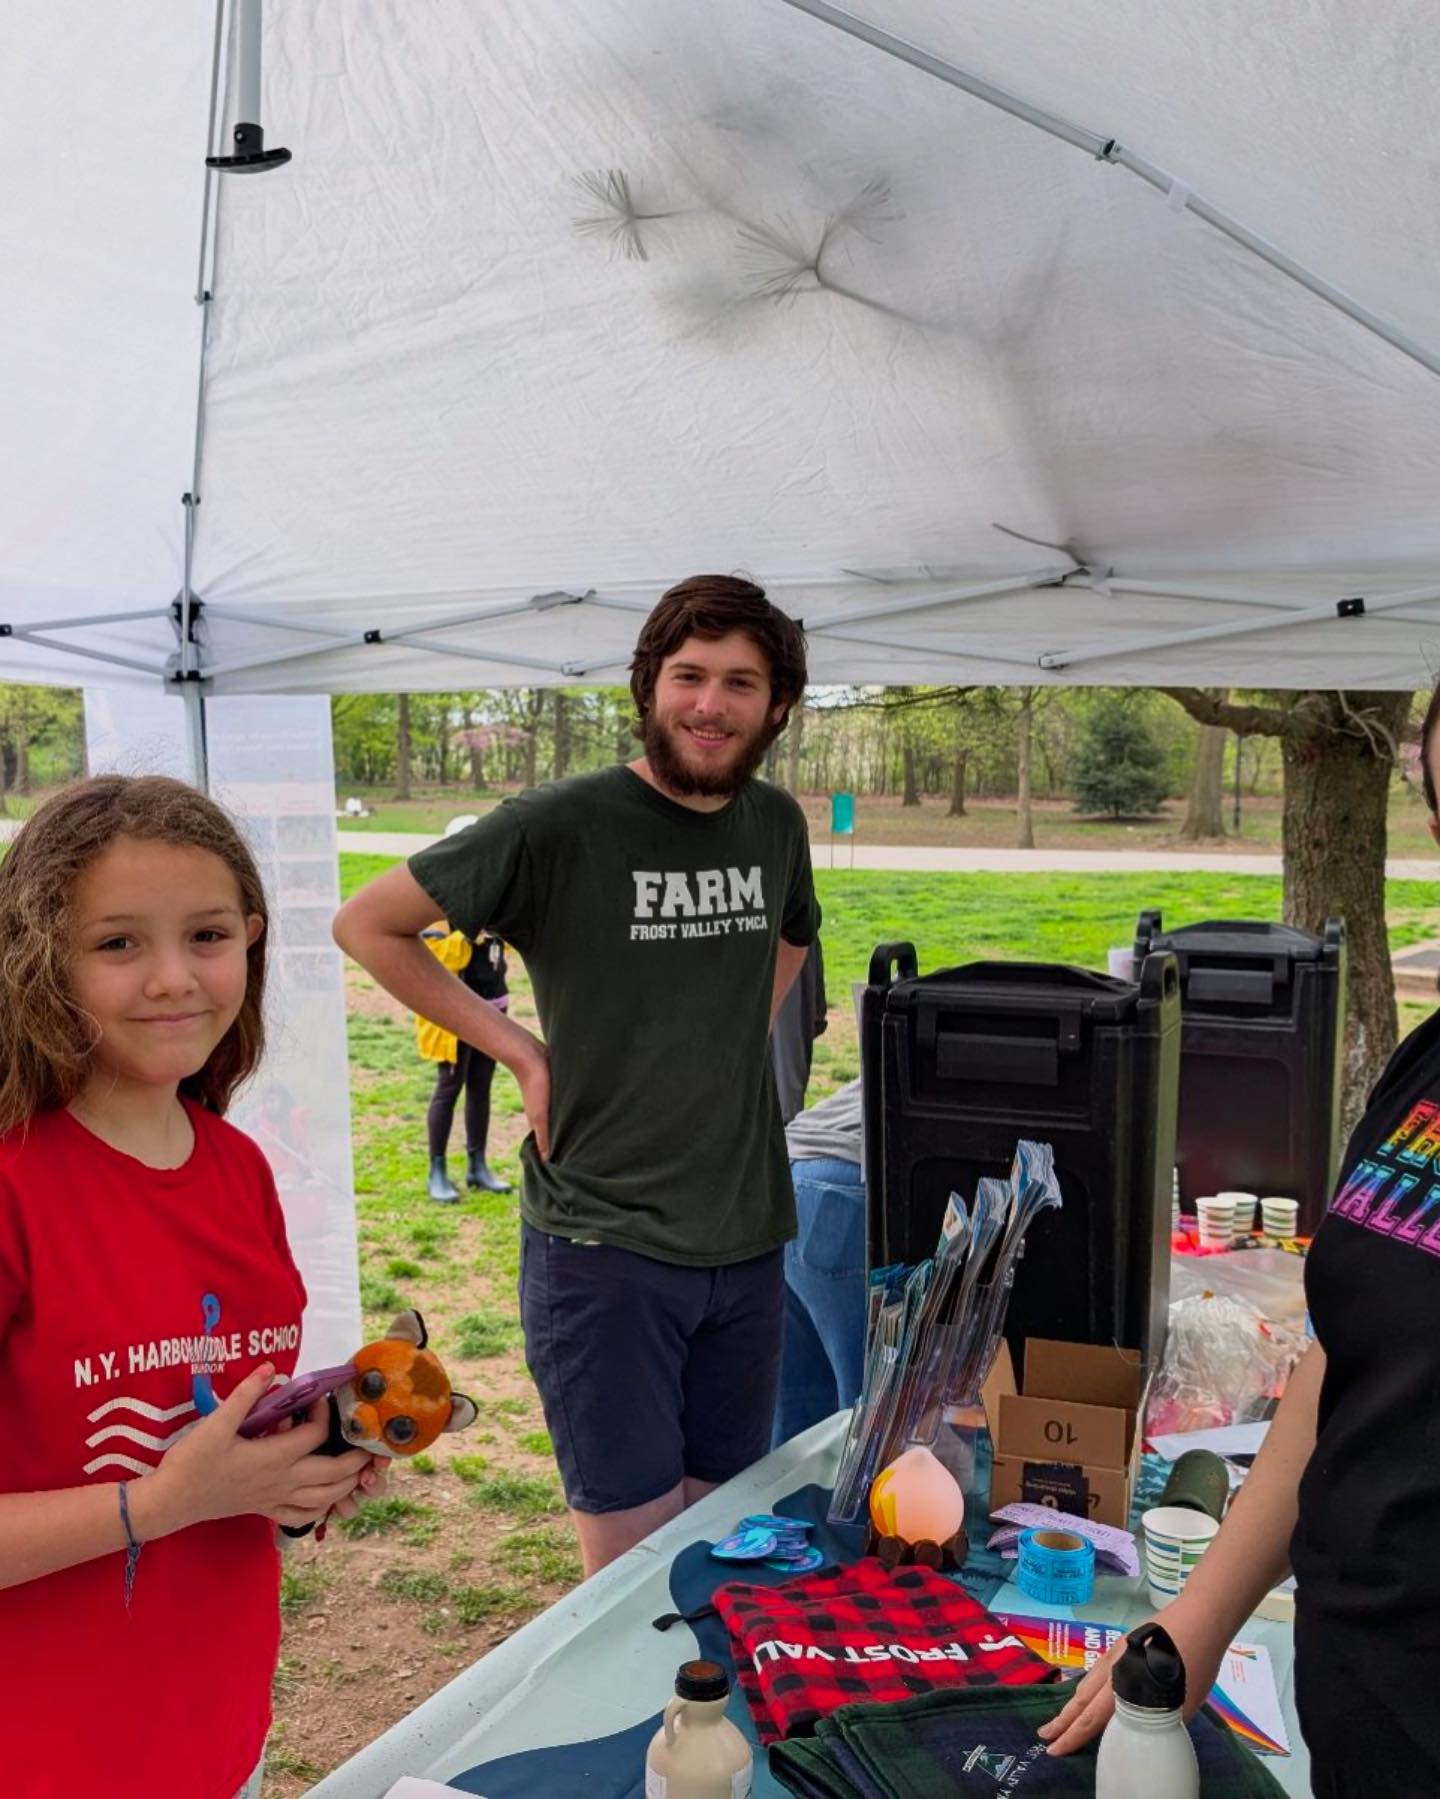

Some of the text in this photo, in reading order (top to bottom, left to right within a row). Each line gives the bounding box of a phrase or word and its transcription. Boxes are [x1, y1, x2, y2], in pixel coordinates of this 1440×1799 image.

[632, 866, 765, 917] FARM
[630, 915, 768, 941] FROST VALLEY YMCA
[74, 1351, 120, 1388] N.Y.
[248, 1323, 299, 1356] SCHOO
[1044, 1420, 1078, 1445] 10
[1084, 1626, 1101, 1649] AND
[844, 1643, 968, 1663] FROST
